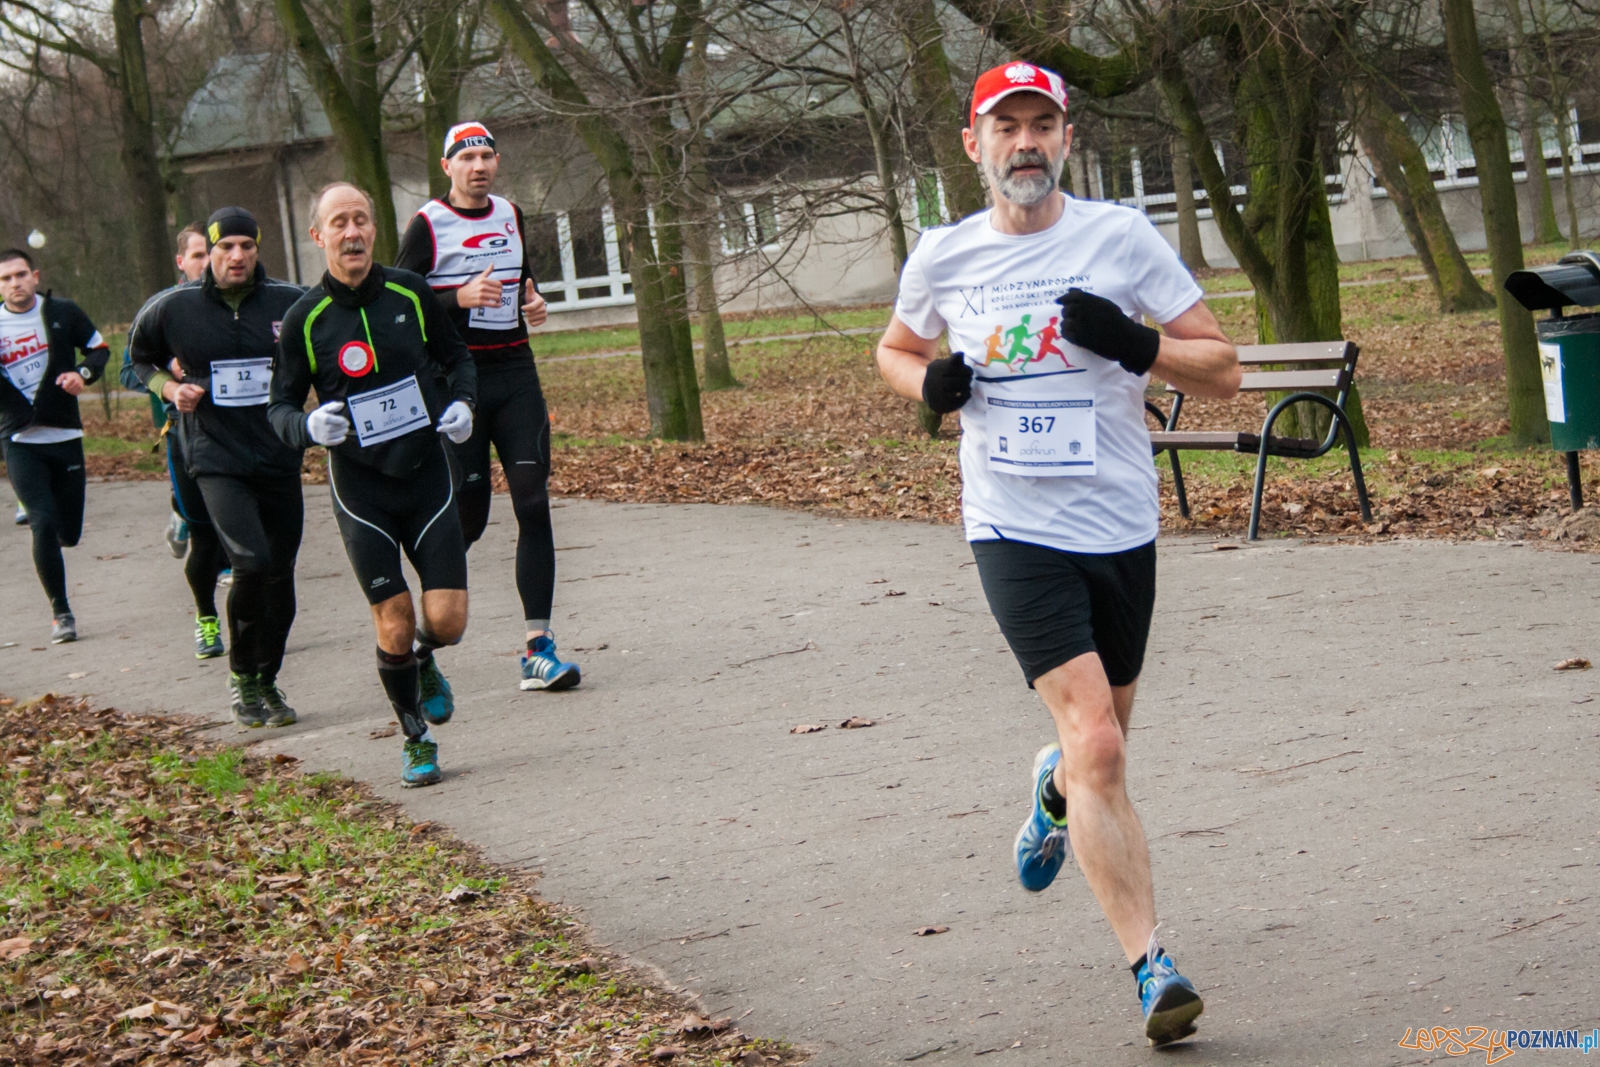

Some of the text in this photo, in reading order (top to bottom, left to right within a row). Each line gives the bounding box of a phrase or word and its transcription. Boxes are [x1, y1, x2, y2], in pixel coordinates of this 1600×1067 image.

[463, 136, 489, 147] TREK
[959, 285, 985, 318] XI
[24, 361, 41, 374] 370
[237, 370, 251, 381] 12
[379, 398, 397, 412] 72
[1018, 416, 1056, 433] 367
[1020, 445, 1056, 456] parkrun
